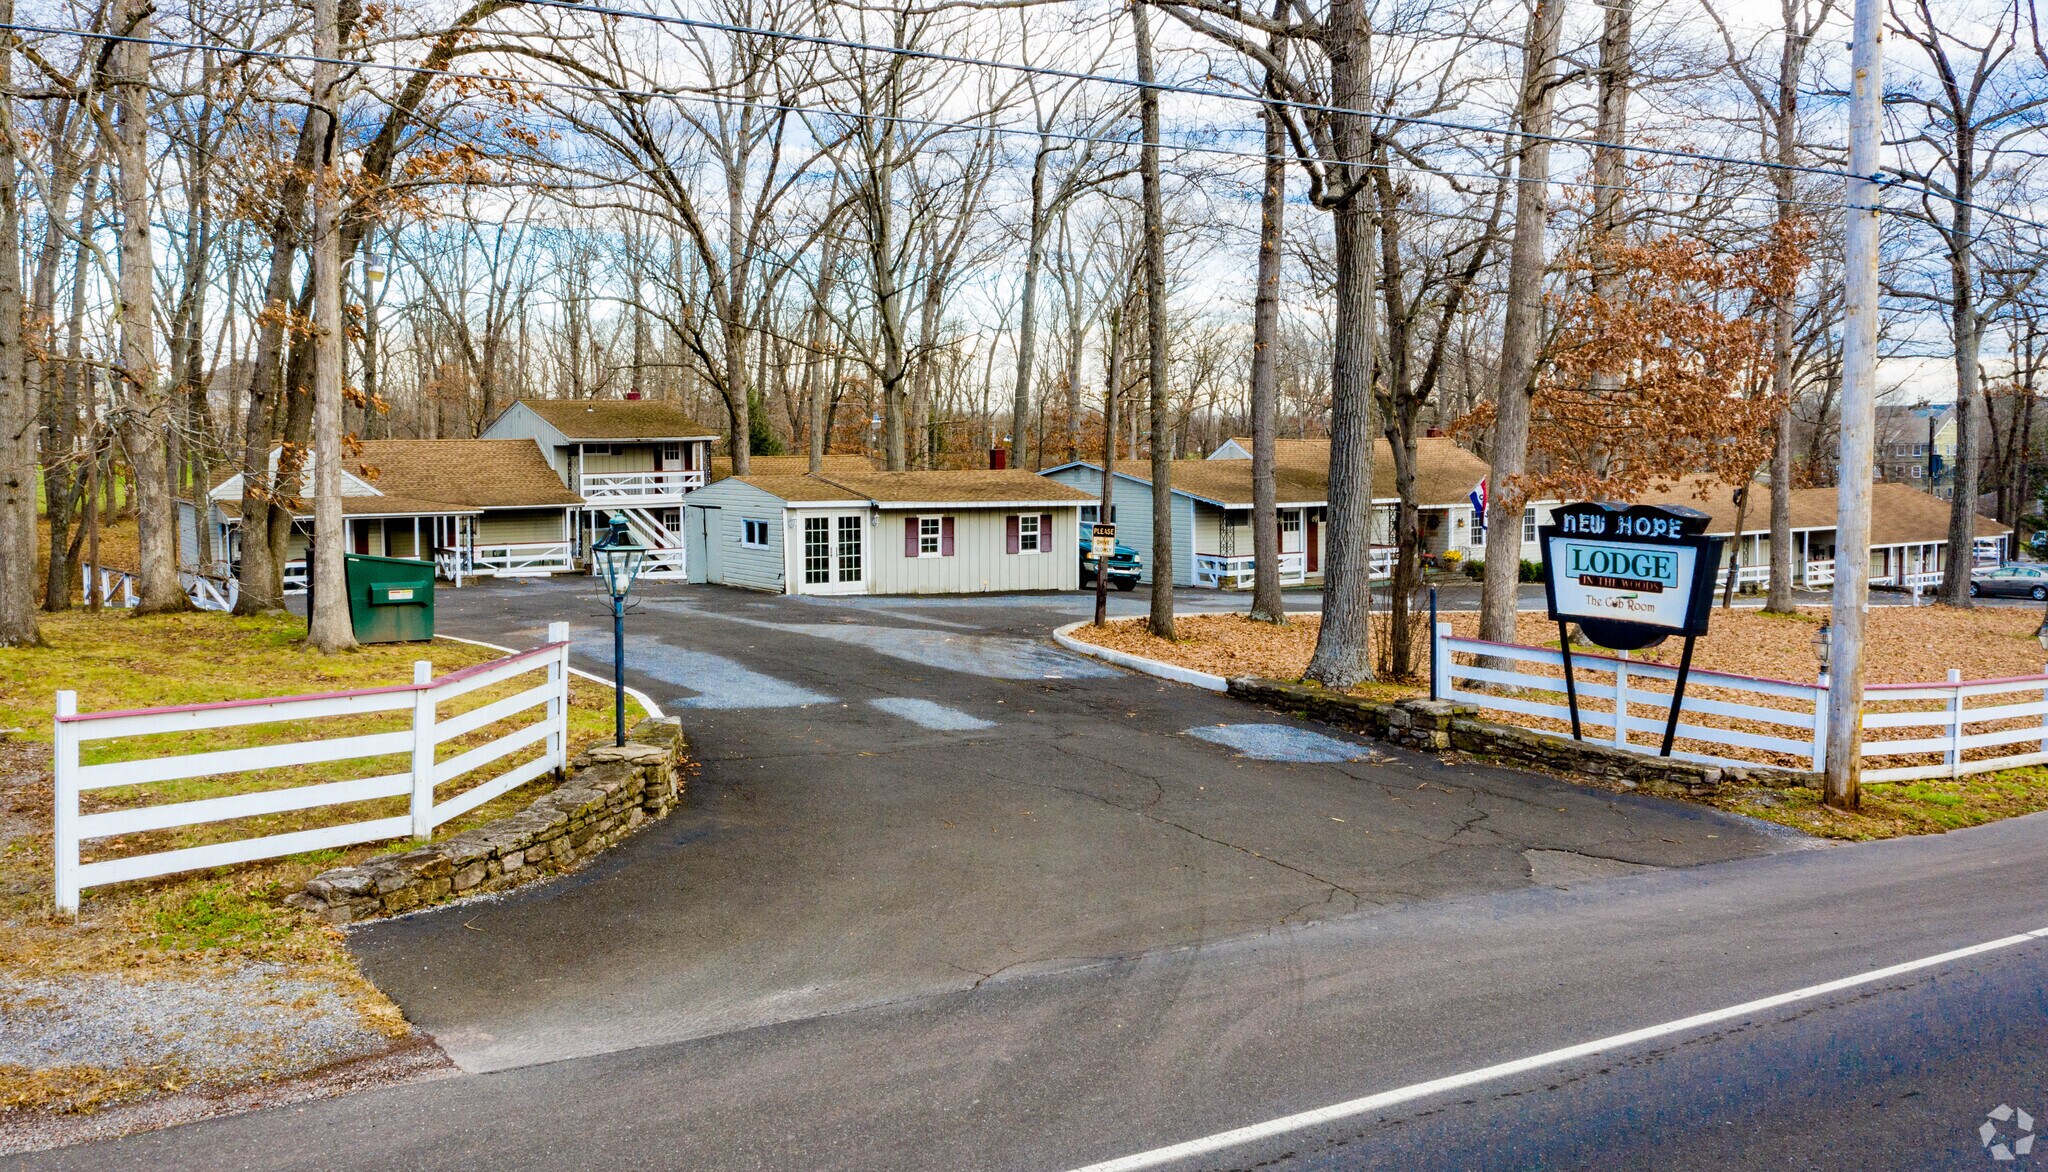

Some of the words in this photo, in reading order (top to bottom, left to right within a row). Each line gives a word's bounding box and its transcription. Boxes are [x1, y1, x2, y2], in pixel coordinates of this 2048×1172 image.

[1093, 527, 1114, 535] PLEASE
[1615, 515, 1683, 539] HOPE
[1572, 549, 1671, 579] LODGE
[1583, 575, 1594, 585] IN
[1599, 577, 1617, 588] THE
[1621, 579, 1660, 591] WOODS
[1586, 594, 1602, 607] The
[1605, 596, 1624, 609] Cub
[1627, 599, 1656, 613] Room
